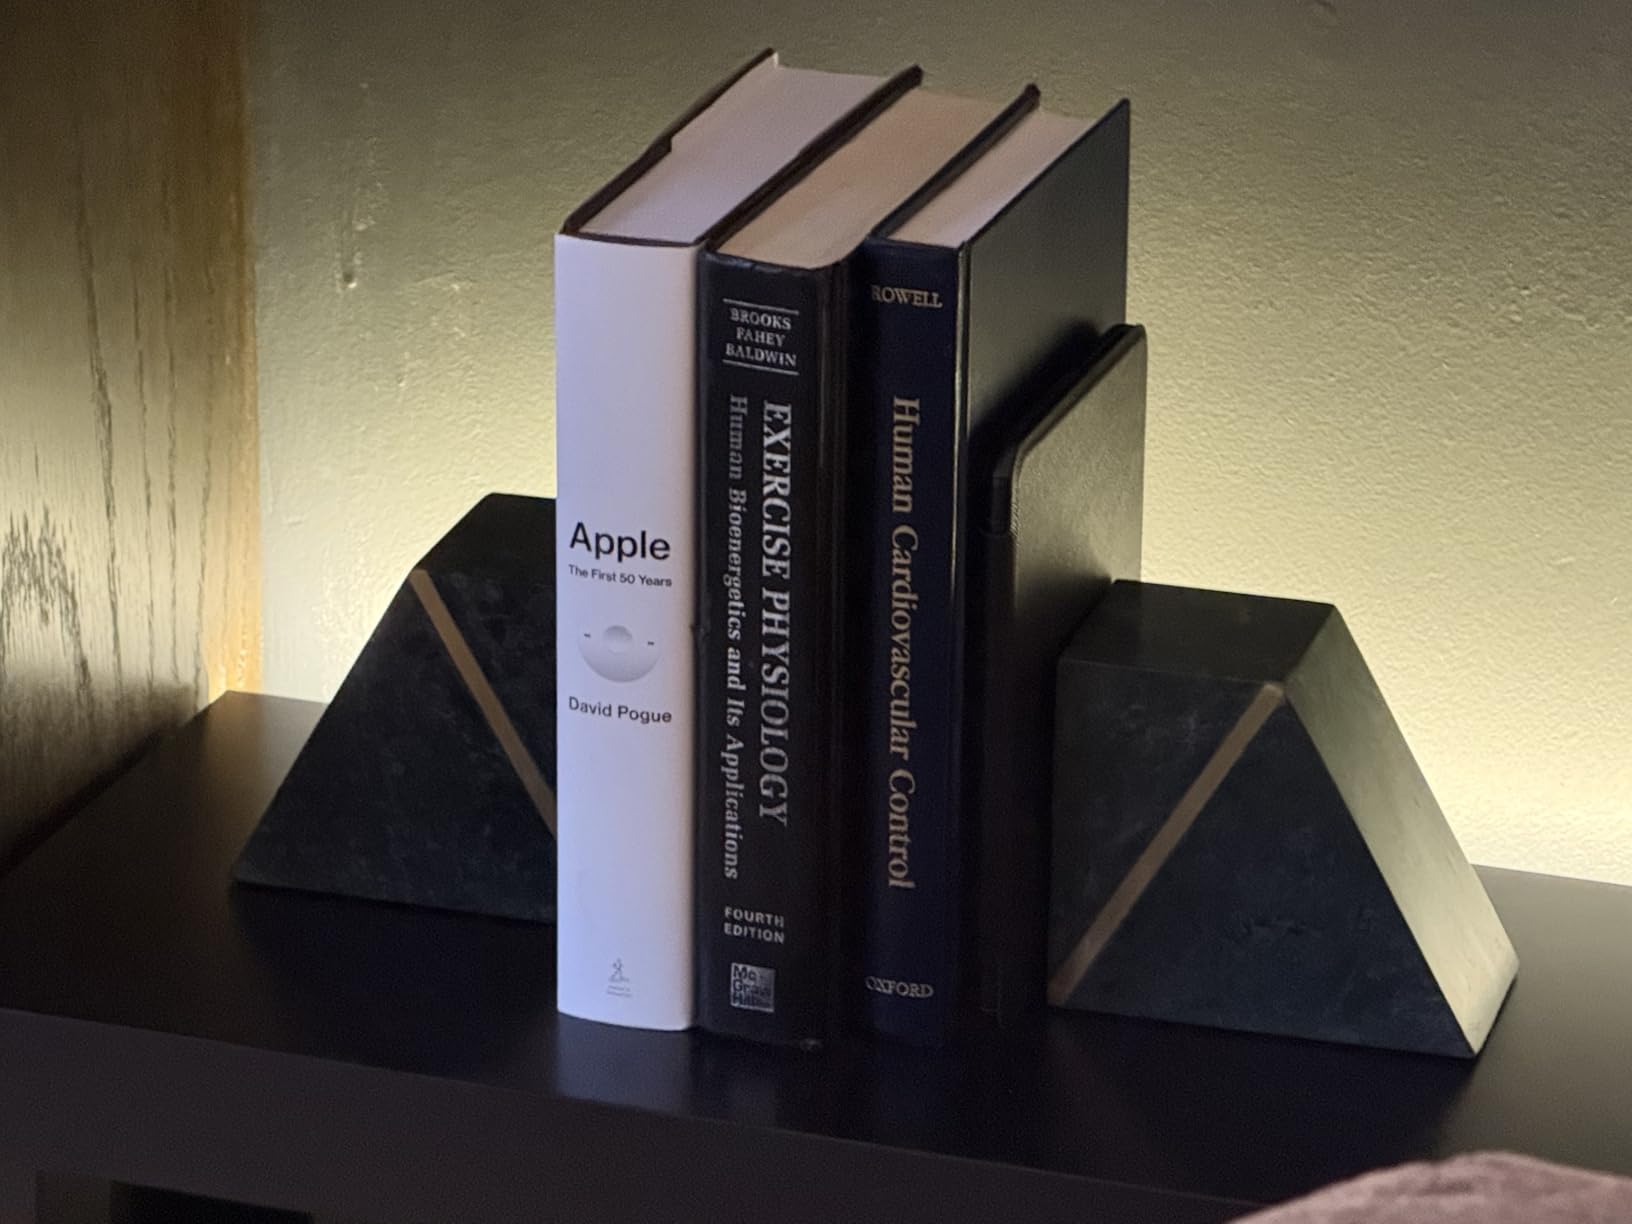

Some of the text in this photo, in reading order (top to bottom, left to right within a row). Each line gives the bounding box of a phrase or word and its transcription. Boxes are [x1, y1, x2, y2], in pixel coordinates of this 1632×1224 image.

[870, 284, 943, 308] ROWELL
[730, 307, 792, 331] BROOKS
[736, 326, 786, 347] FAHEY
[725, 343, 797, 367] BALDWIN
[570, 522, 671, 563] Apple
[568, 564, 672, 587] The First 50 Years
[759, 400, 792, 826] EXERCISE PHYSIOLOGY
[720, 394, 748, 880] Human Bioenergetics and Its Applications
[888, 395, 921, 889] Human Cardiovascular Control
[568, 696, 673, 725] David Pogue
[724, 906, 785, 928] FOURTH
[723, 922, 785, 944] EDITION
[865, 976, 934, 998] OXFORD
